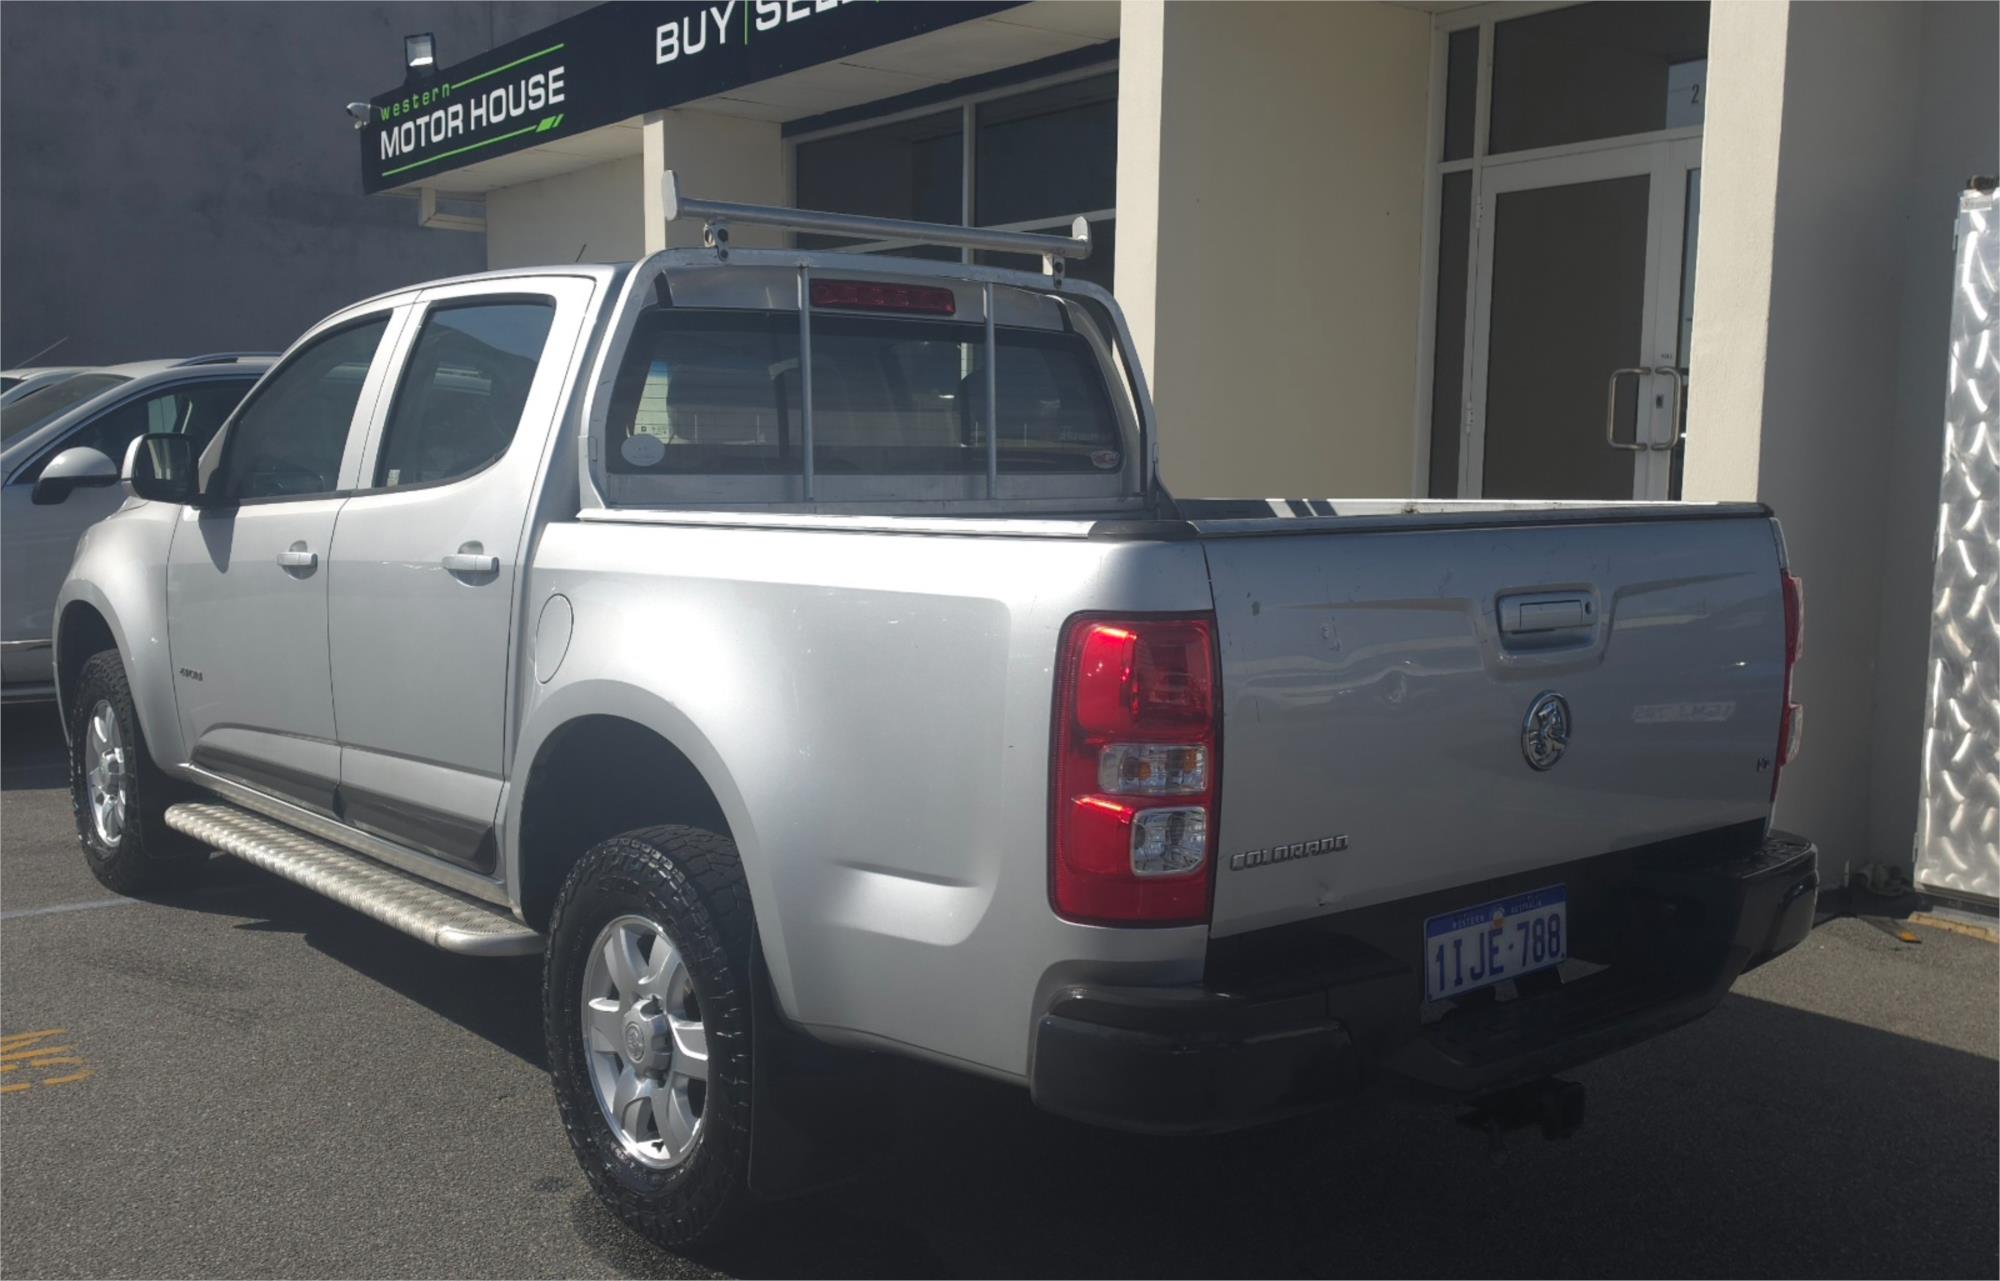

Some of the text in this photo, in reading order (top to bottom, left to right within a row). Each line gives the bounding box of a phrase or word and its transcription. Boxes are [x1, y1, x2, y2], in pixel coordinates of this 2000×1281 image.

[656, 0, 856, 65] BUY SE
[380, 83, 450, 121] western
[380, 65, 565, 160] MOTOR HOUSE
[1691, 83, 1700, 104] 2
[1230, 834, 1349, 872] COLORADO
